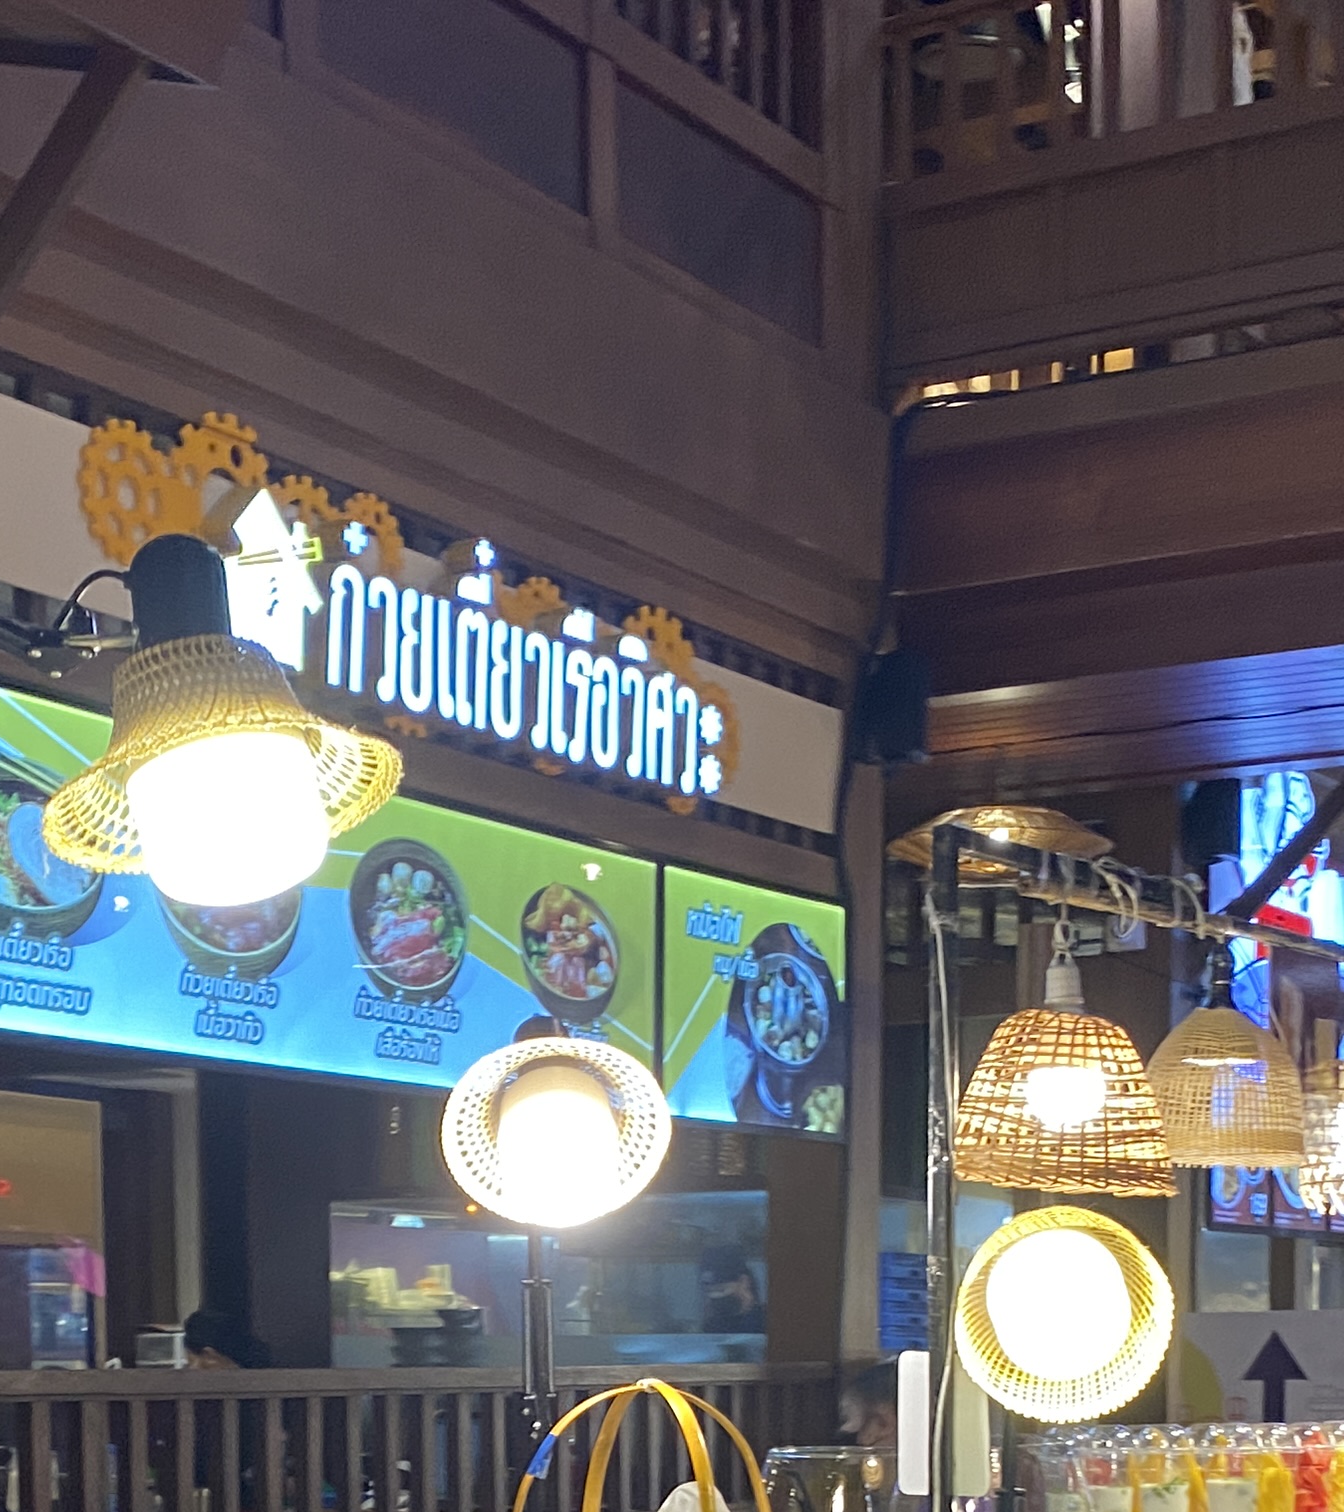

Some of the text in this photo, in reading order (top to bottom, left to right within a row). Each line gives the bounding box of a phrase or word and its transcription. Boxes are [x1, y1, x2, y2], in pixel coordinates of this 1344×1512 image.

[326, 519, 724, 797] ก๋วยเตี๋ยวเรือวิศวะ
[180, 964, 277, 1007] ก๋วยเตี๋ยวเรือ
